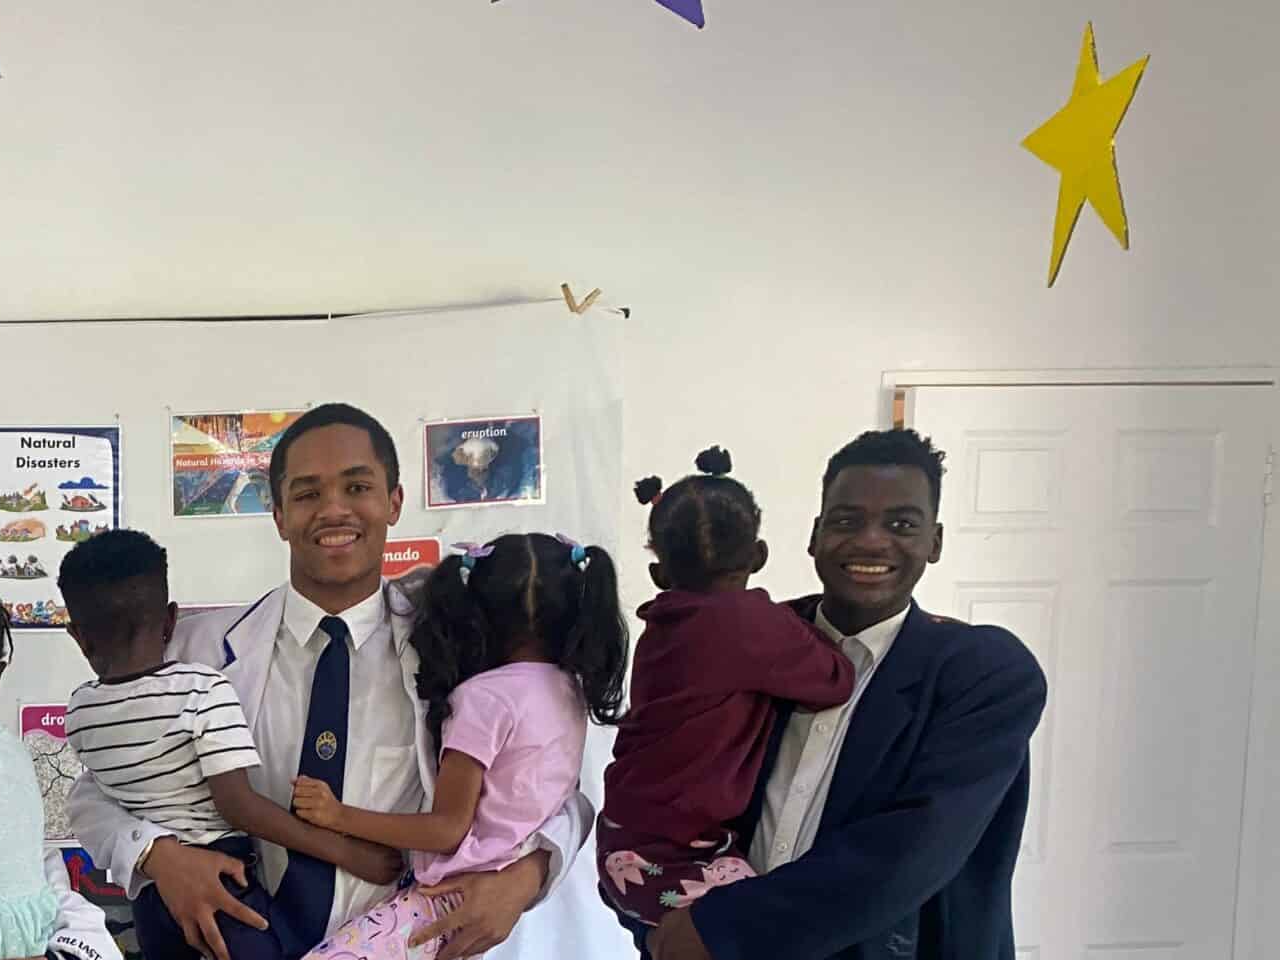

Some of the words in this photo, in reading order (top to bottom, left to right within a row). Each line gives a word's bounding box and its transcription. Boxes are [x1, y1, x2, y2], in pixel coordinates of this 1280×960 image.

[461, 427, 507, 440] eruption
[20, 436, 76, 449] Natural
[16, 456, 81, 469] Disasters
[175, 458, 209, 467] Natural
[41, 712, 65, 726] dro
